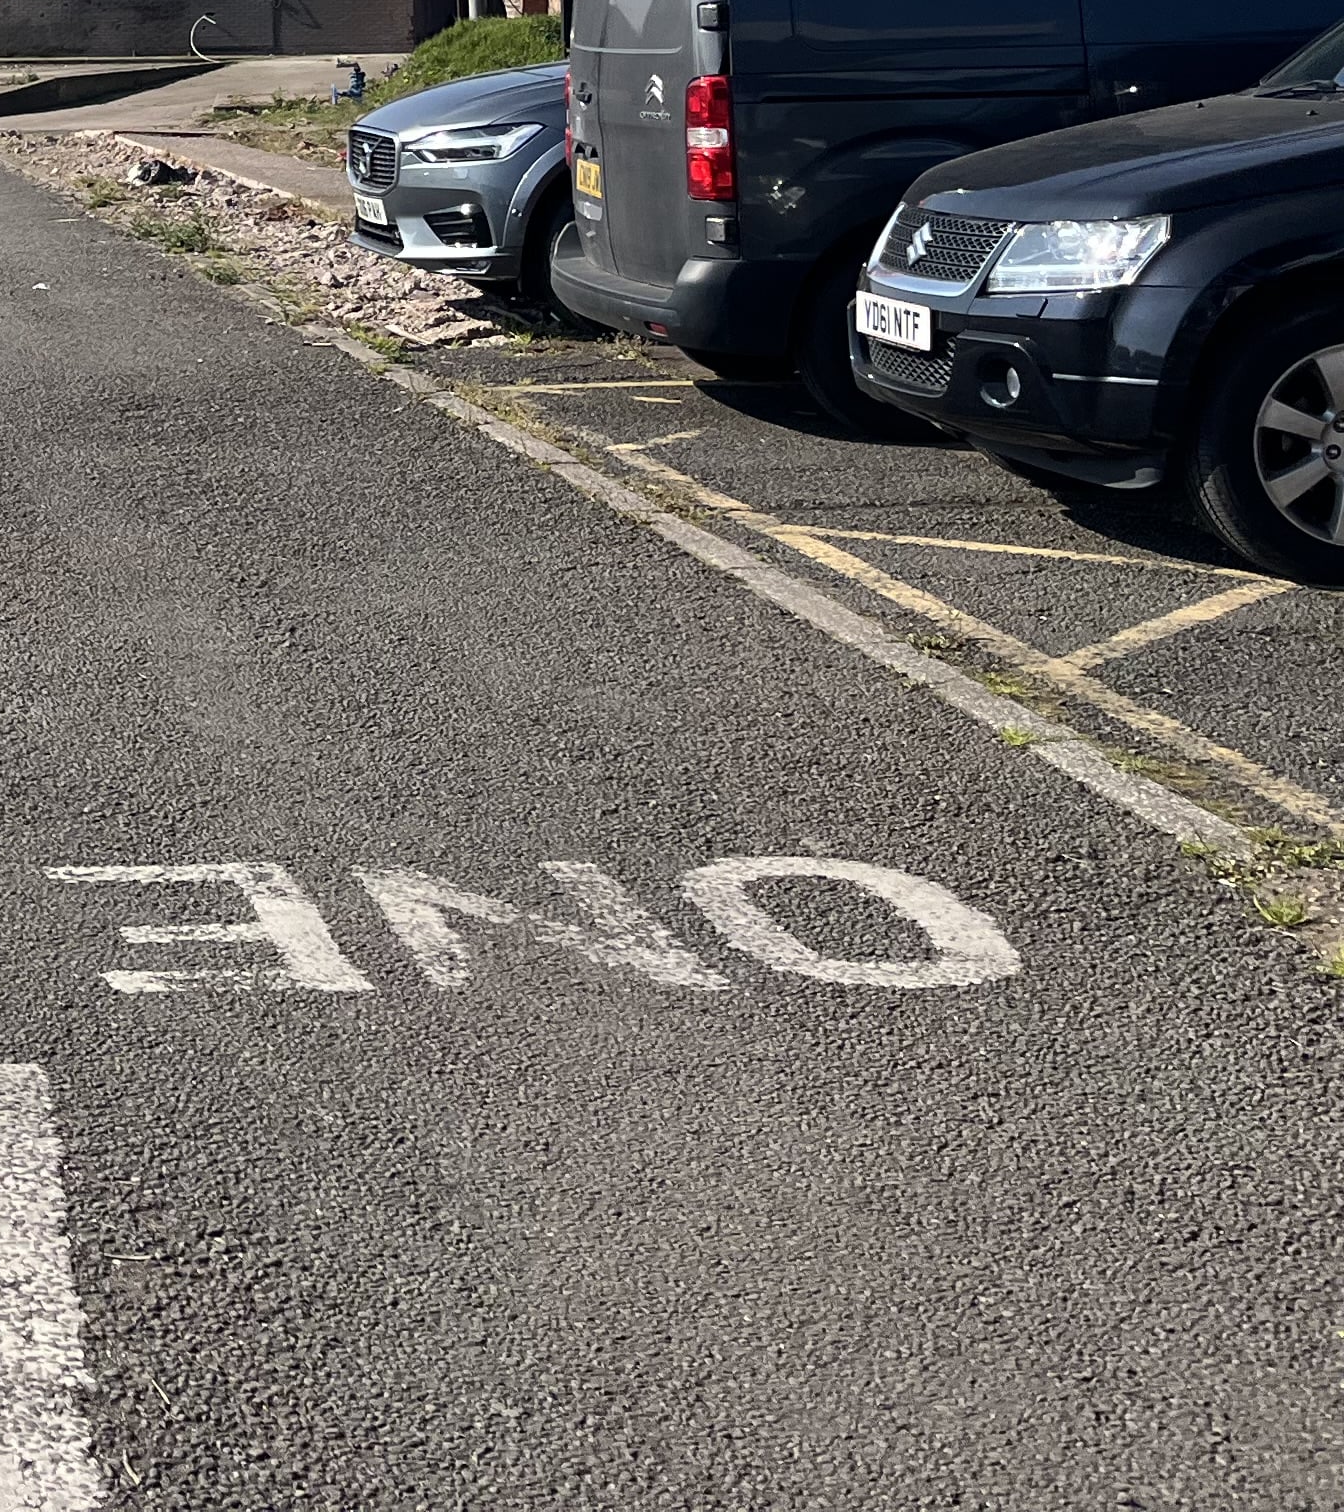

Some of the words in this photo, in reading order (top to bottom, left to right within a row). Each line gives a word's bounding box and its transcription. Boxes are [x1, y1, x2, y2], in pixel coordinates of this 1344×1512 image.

[864, 298, 891, 335] YD61
[894, 306, 921, 342] NTF
[44, 856, 1020, 991] ONE
